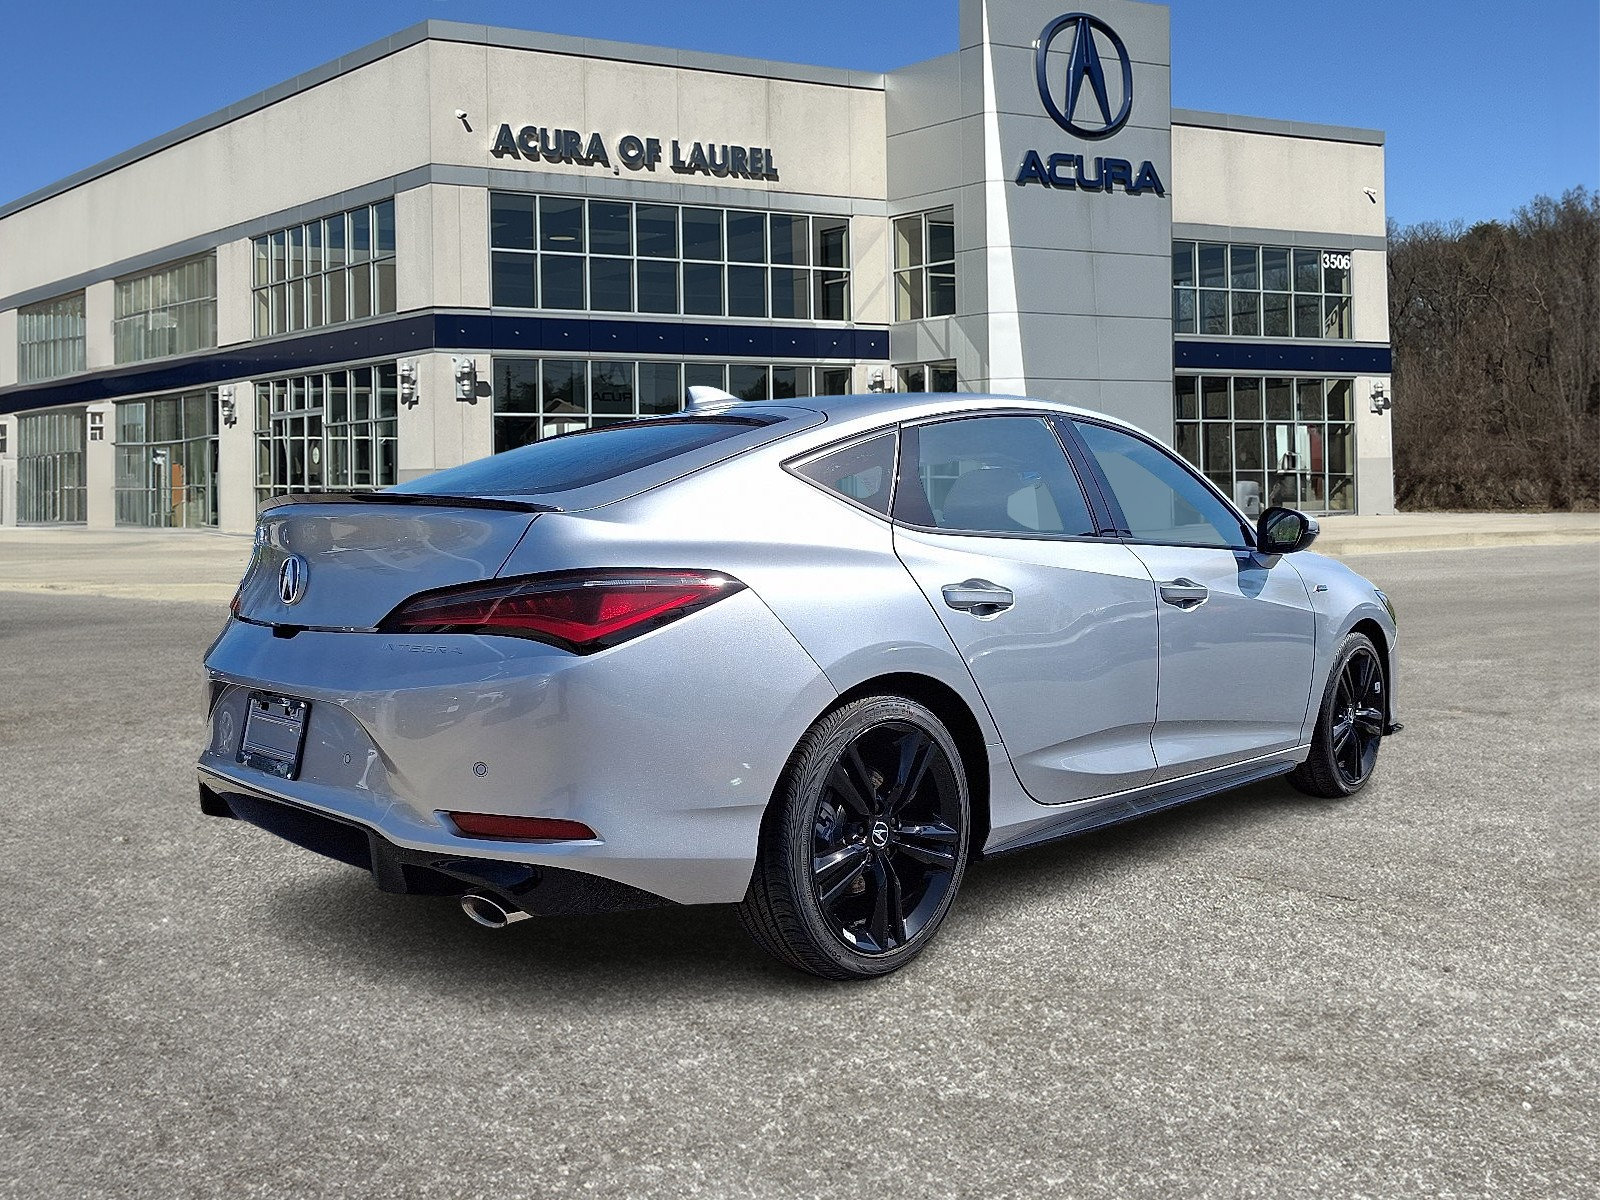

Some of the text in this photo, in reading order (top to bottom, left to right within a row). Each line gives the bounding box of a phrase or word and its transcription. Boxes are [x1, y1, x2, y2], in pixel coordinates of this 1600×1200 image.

[491, 123, 779, 180] ACURA OF LAUREL
[1015, 150, 1165, 196] ACURA
[1322, 253, 1350, 269] 3506
[381, 643, 463, 655] INTEGRA
